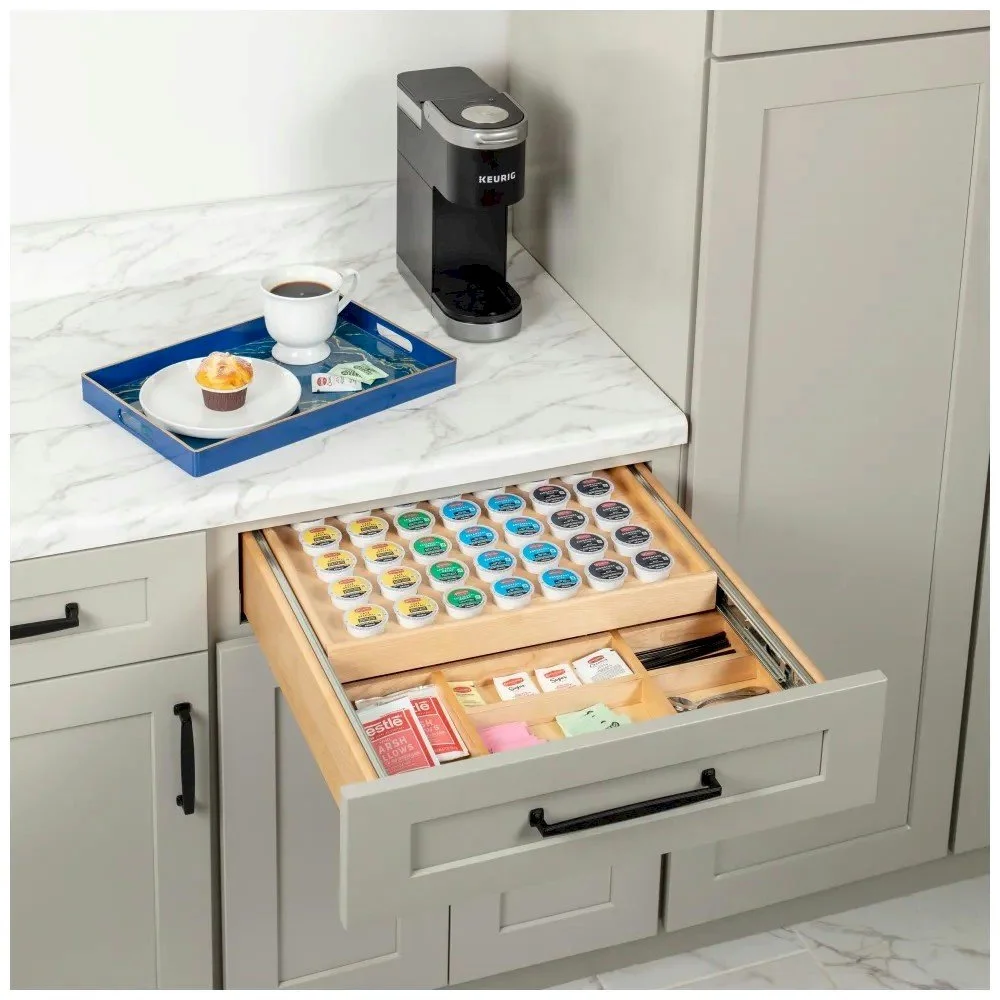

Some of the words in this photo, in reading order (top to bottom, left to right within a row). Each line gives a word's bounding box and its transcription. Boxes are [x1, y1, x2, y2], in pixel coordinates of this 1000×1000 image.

[478, 171, 516, 183] KEURIG
[365, 715, 404, 738] estlé
[378, 735, 408, 756] ARSH
